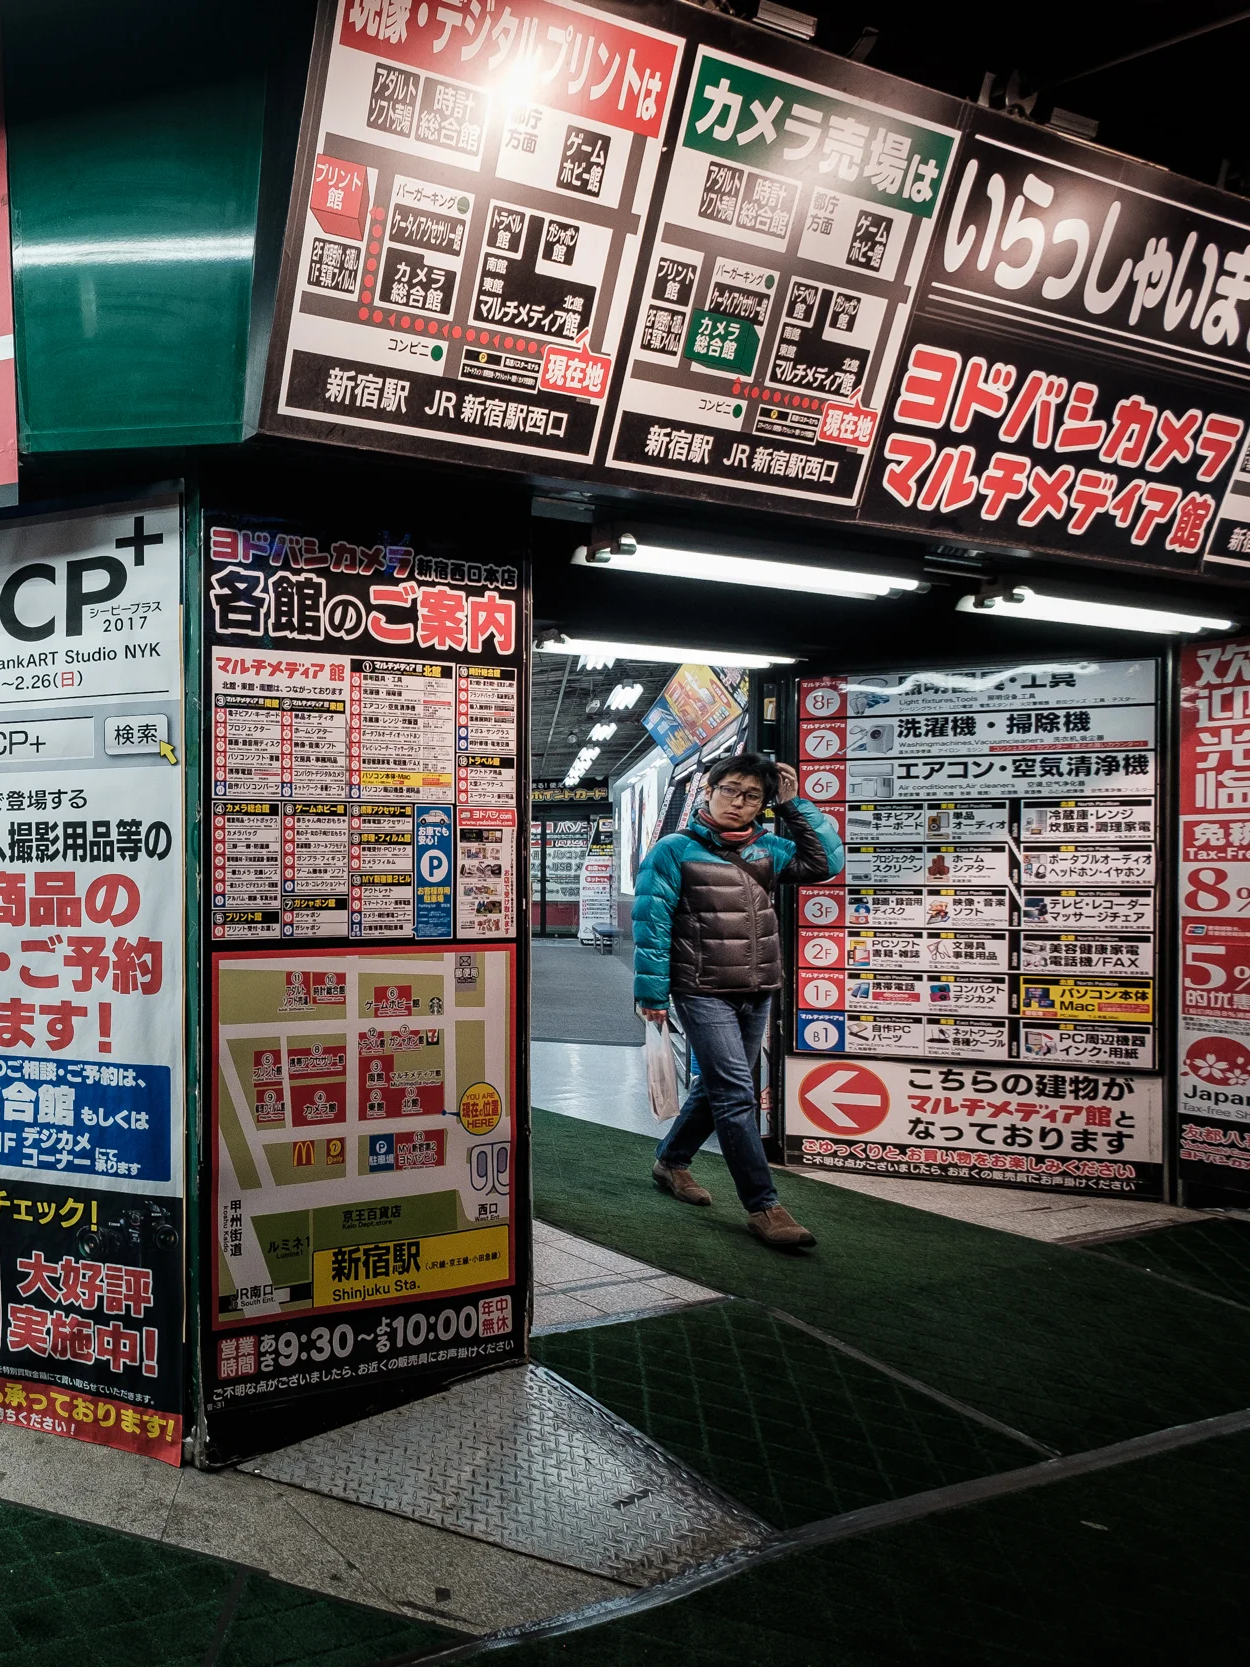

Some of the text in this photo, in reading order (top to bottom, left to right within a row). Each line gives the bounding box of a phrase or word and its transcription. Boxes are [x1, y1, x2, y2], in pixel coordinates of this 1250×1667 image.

[417, 110, 481, 152] 総合館
[695, 77, 939, 203] カメラ売場は
[566, 131, 605, 165] ゲーム
[316, 164, 361, 191] プリント
[486, 257, 508, 274] 南館
[943, 159, 1250, 350] いらっしゃいま
[395, 262, 445, 288] カメラ
[391, 280, 444, 312] 総合館
[479, 295, 581, 337] マルチメディア館
[699, 317, 740, 339] カメラ
[388, 339, 429, 356] コンビニ
[694, 335, 737, 360] 総合館
[546, 355, 604, 392] 現在地
[326, 369, 568, 438] 新宿駅 JR 新宿駅西口
[893, 343, 1245, 481] ヨドバシカメラ
[824, 409, 873, 442] 現在地
[646, 427, 839, 483] 新宿駅 JR 新宿駅西口
[882, 432, 1216, 554] マルチメディア館
[211, 527, 518, 590] ヨドバシカメラ 新宿西口本店
[89, 600, 162, 619] シーピープラス
[210, 566, 516, 655] 各館のご案内
[103, 616, 149, 633] 2017
[64, 646, 118, 666] Studio
[124, 642, 162, 660] NYK
[215, 656, 346, 682] マルチメディア館
[114, 724, 159, 746] 検索
[897, 710, 1091, 738] 洗濯機・掃除機
[812, 735, 834, 752] 7F
[896, 754, 1149, 780] エアコン・空気清浄機
[811, 777, 835, 793] 6F
[1048, 808, 1134, 820] 冷蔵庫・レンジ
[418, 827, 449, 835] お車でも
[1048, 821, 1151, 833] 炊飯器・調理家電
[811, 902, 833, 919] 3F
[1049, 898, 1150, 910] テレビ・レコーダー
[1049, 911, 1145, 923] マッサージチェア
[811, 944, 832, 959] 2F
[1049, 956, 1139, 968] 電話機/FAX
[813, 985, 832, 999] 1F
[1059, 987, 1150, 1001] パソコン本体
[1059, 1000, 1095, 1012] Mac
[813, 1027, 828, 1043] B1
[1059, 1032, 1145, 1047] PC周辺機器
[1059, 1045, 1139, 1060] インク・用紙
[482, 1092, 495, 1100] ARE
[907, 1067, 1136, 1101] こちらの建物が
[80, 1106, 150, 1130] もしくは
[467, 1119, 494, 1129] HERE
[22, 1126, 92, 1151] デジカメ
[907, 1117, 1135, 1154] なっております
[22, 1148, 91, 1168] コーナー
[802, 1139, 1136, 1179] ごゆっくりと、お買い物をお楽しみください
[342, 1204, 402, 1223] 京王百貨店
[478, 1202, 498, 1216] 西口
[230, 1200, 242, 1257] 甲州街道
[331, 1240, 422, 1283] 新宿駅
[16, 1251, 153, 1319] 大好評
[332, 1278, 421, 1302] Shinjuku Sta.
[481, 1297, 508, 1316] 年中
[392, 1305, 478, 1348] 10:00
[481, 1316, 510, 1334] 無休
[6, 1303, 159, 1379] 実施中!
[221, 1336, 255, 1356] 営業
[278, 1323, 354, 1368] 9:30
[221, 1356, 255, 1378] 時間
